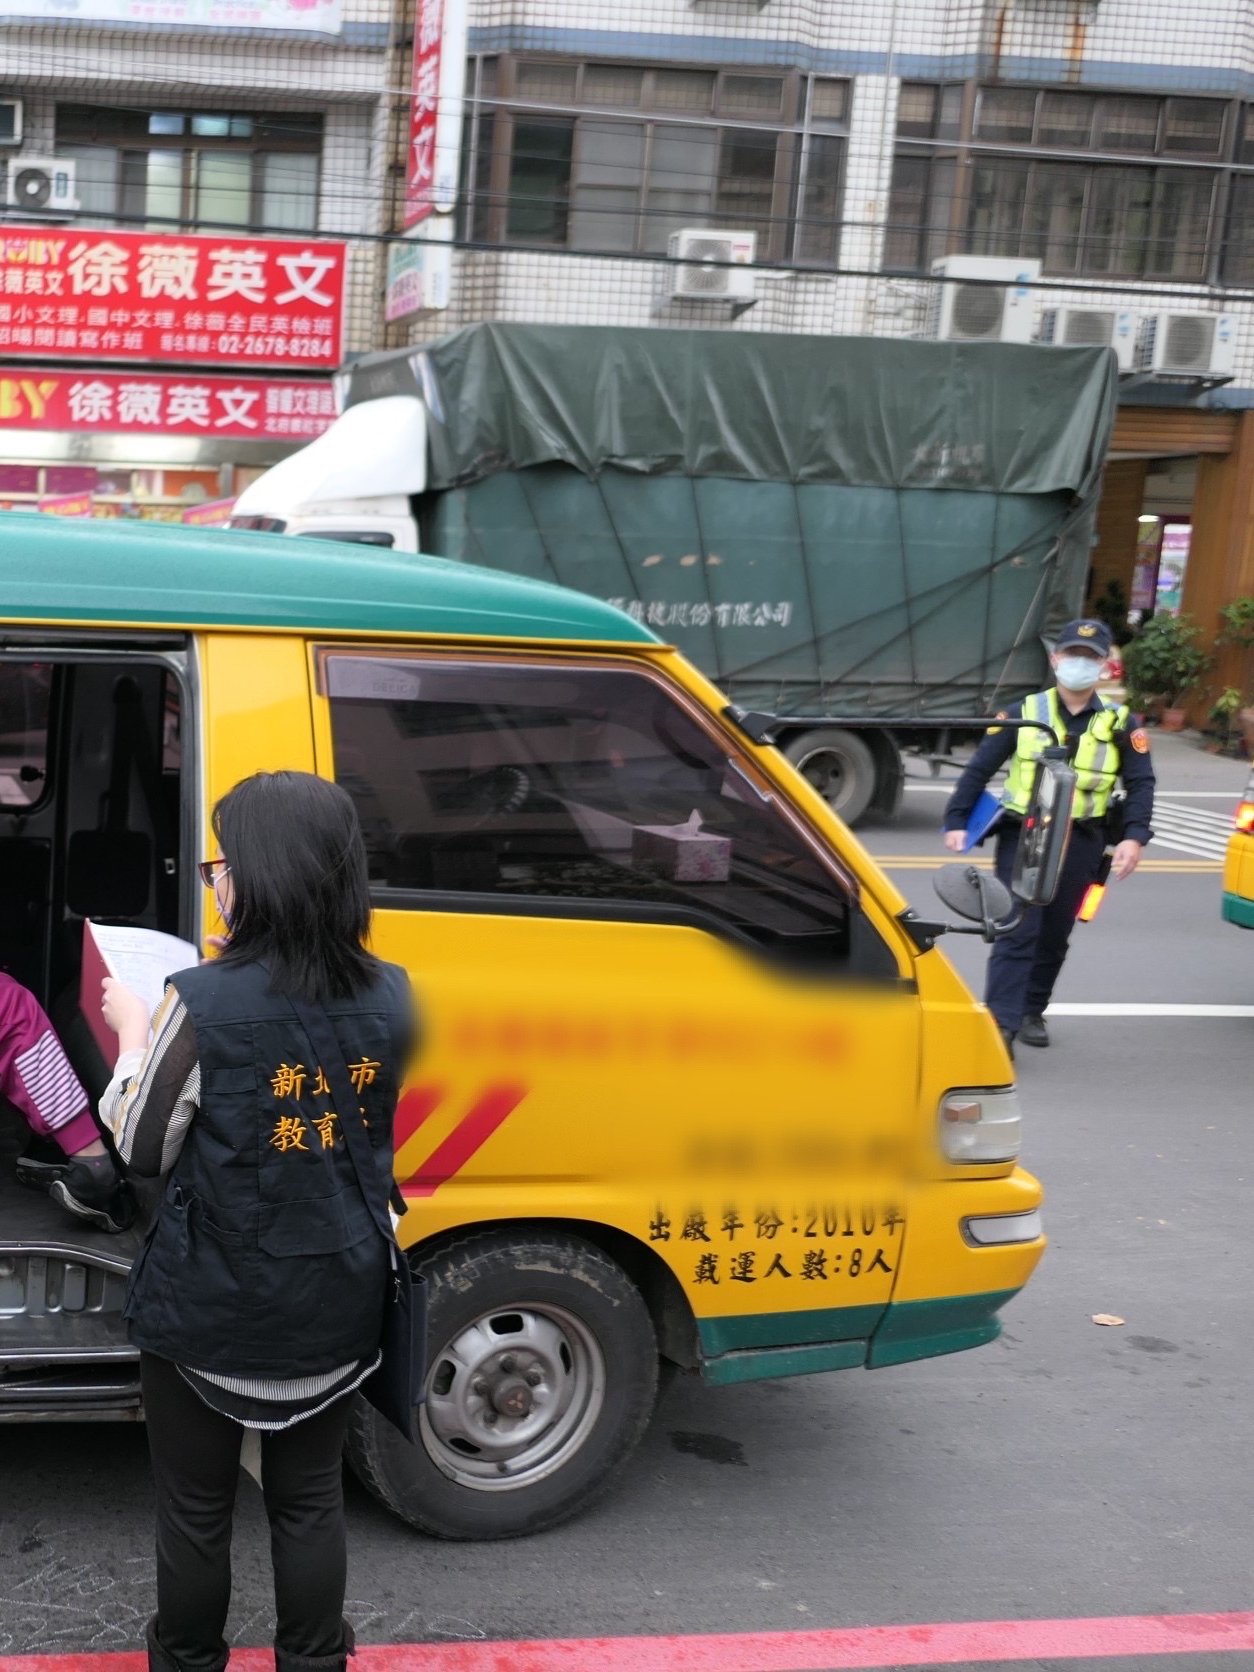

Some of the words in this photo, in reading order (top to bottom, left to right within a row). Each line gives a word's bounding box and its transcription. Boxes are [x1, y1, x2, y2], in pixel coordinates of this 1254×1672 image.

[67, 240, 337, 307] 徐薇英文
[68, 381, 259, 430] 徐薇英文
[269, 1107, 370, 1152] 教育
[692, 1248, 892, 1285] 載運人數:8人
